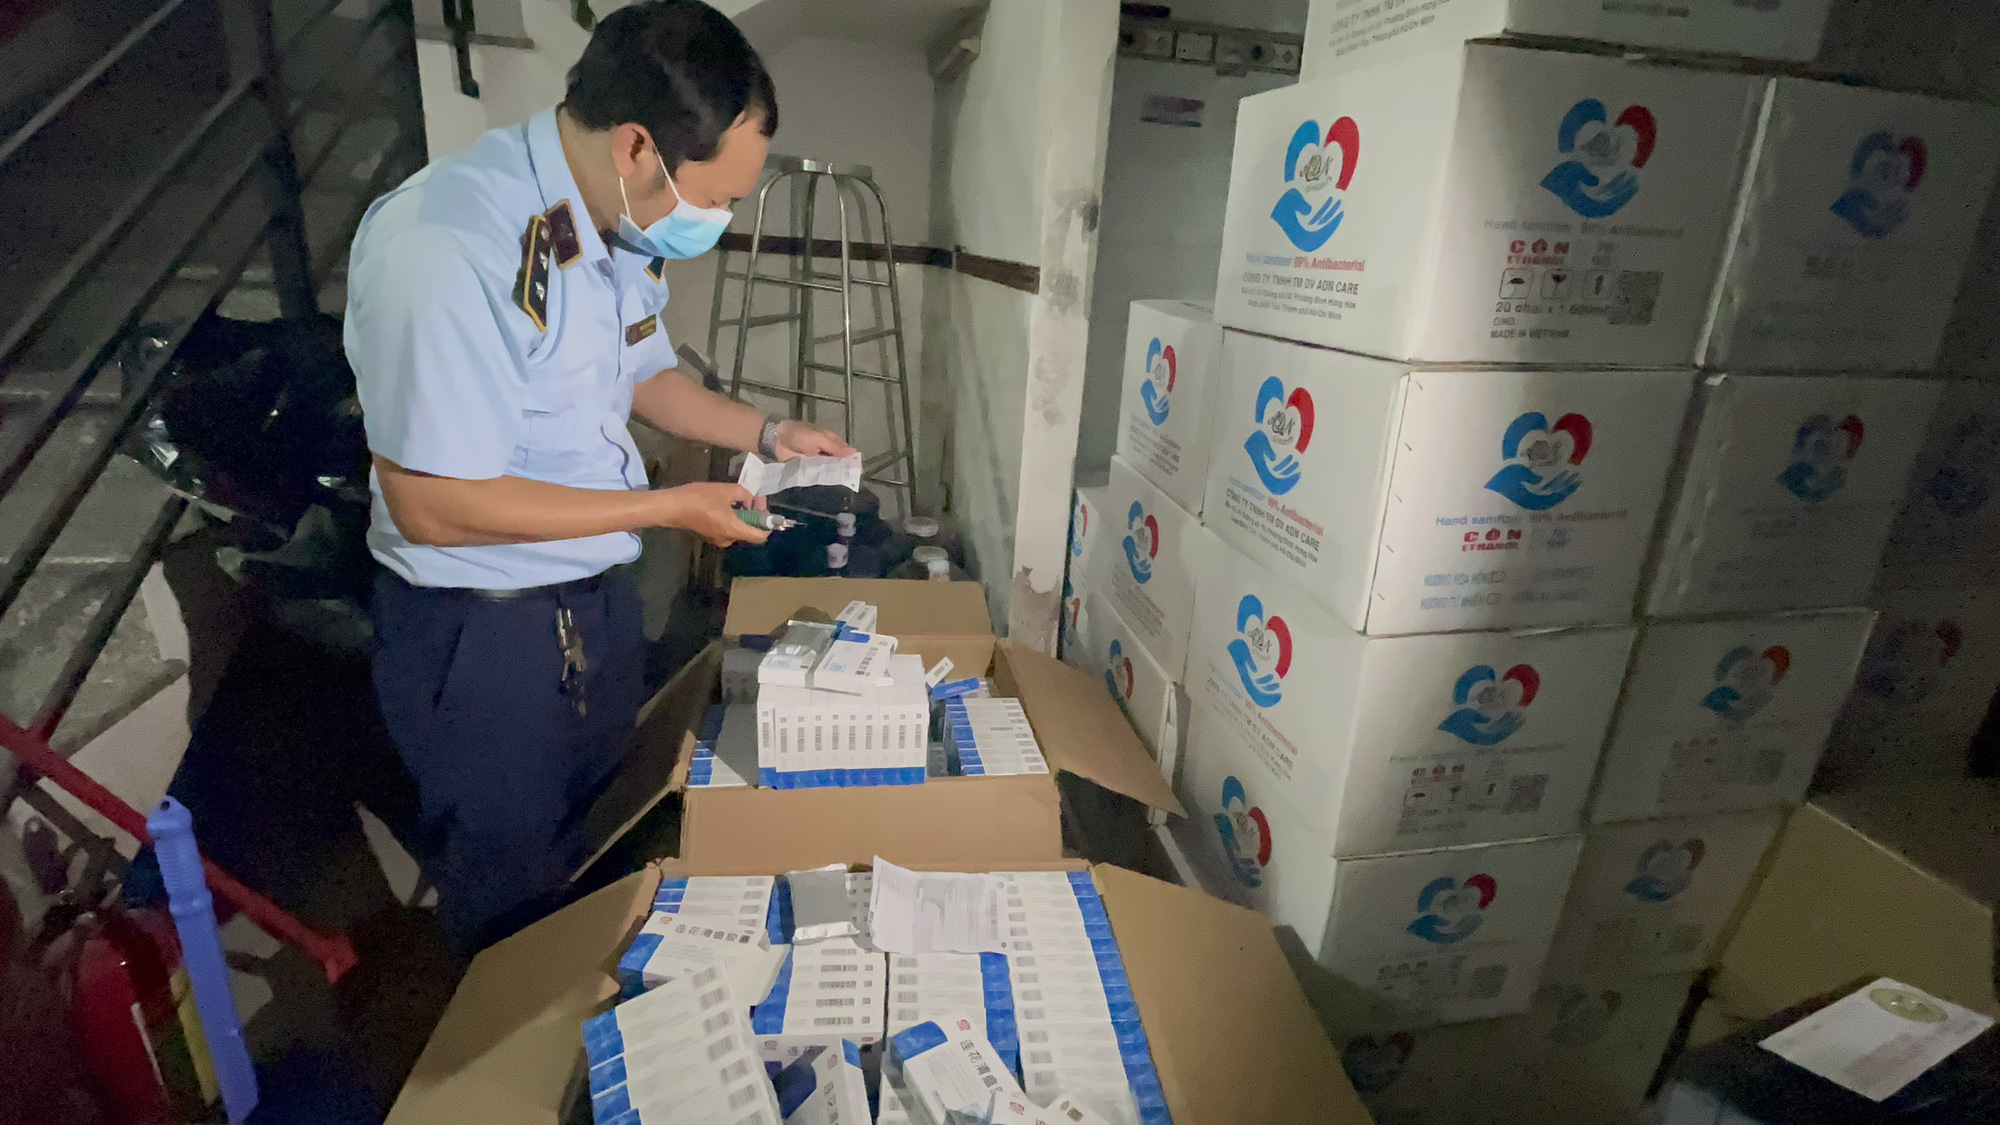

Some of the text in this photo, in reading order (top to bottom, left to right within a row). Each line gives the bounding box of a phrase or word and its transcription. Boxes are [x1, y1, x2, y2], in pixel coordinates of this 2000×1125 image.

[1311, 257, 1366, 271] Antibacterial
[1272, 274, 1292, 287] TNHH
[1304, 278, 1316, 290] DV
[1316, 279, 1335, 292] ADN
[1335, 281, 1360, 295] CARE
[1495, 301, 1511, 313] 20
[1490, 329, 1516, 339] MADE
[1435, 516, 1468, 526] Hand
[1285, 524, 1300, 539] ADN
[1300, 532, 1320, 552] CARE
